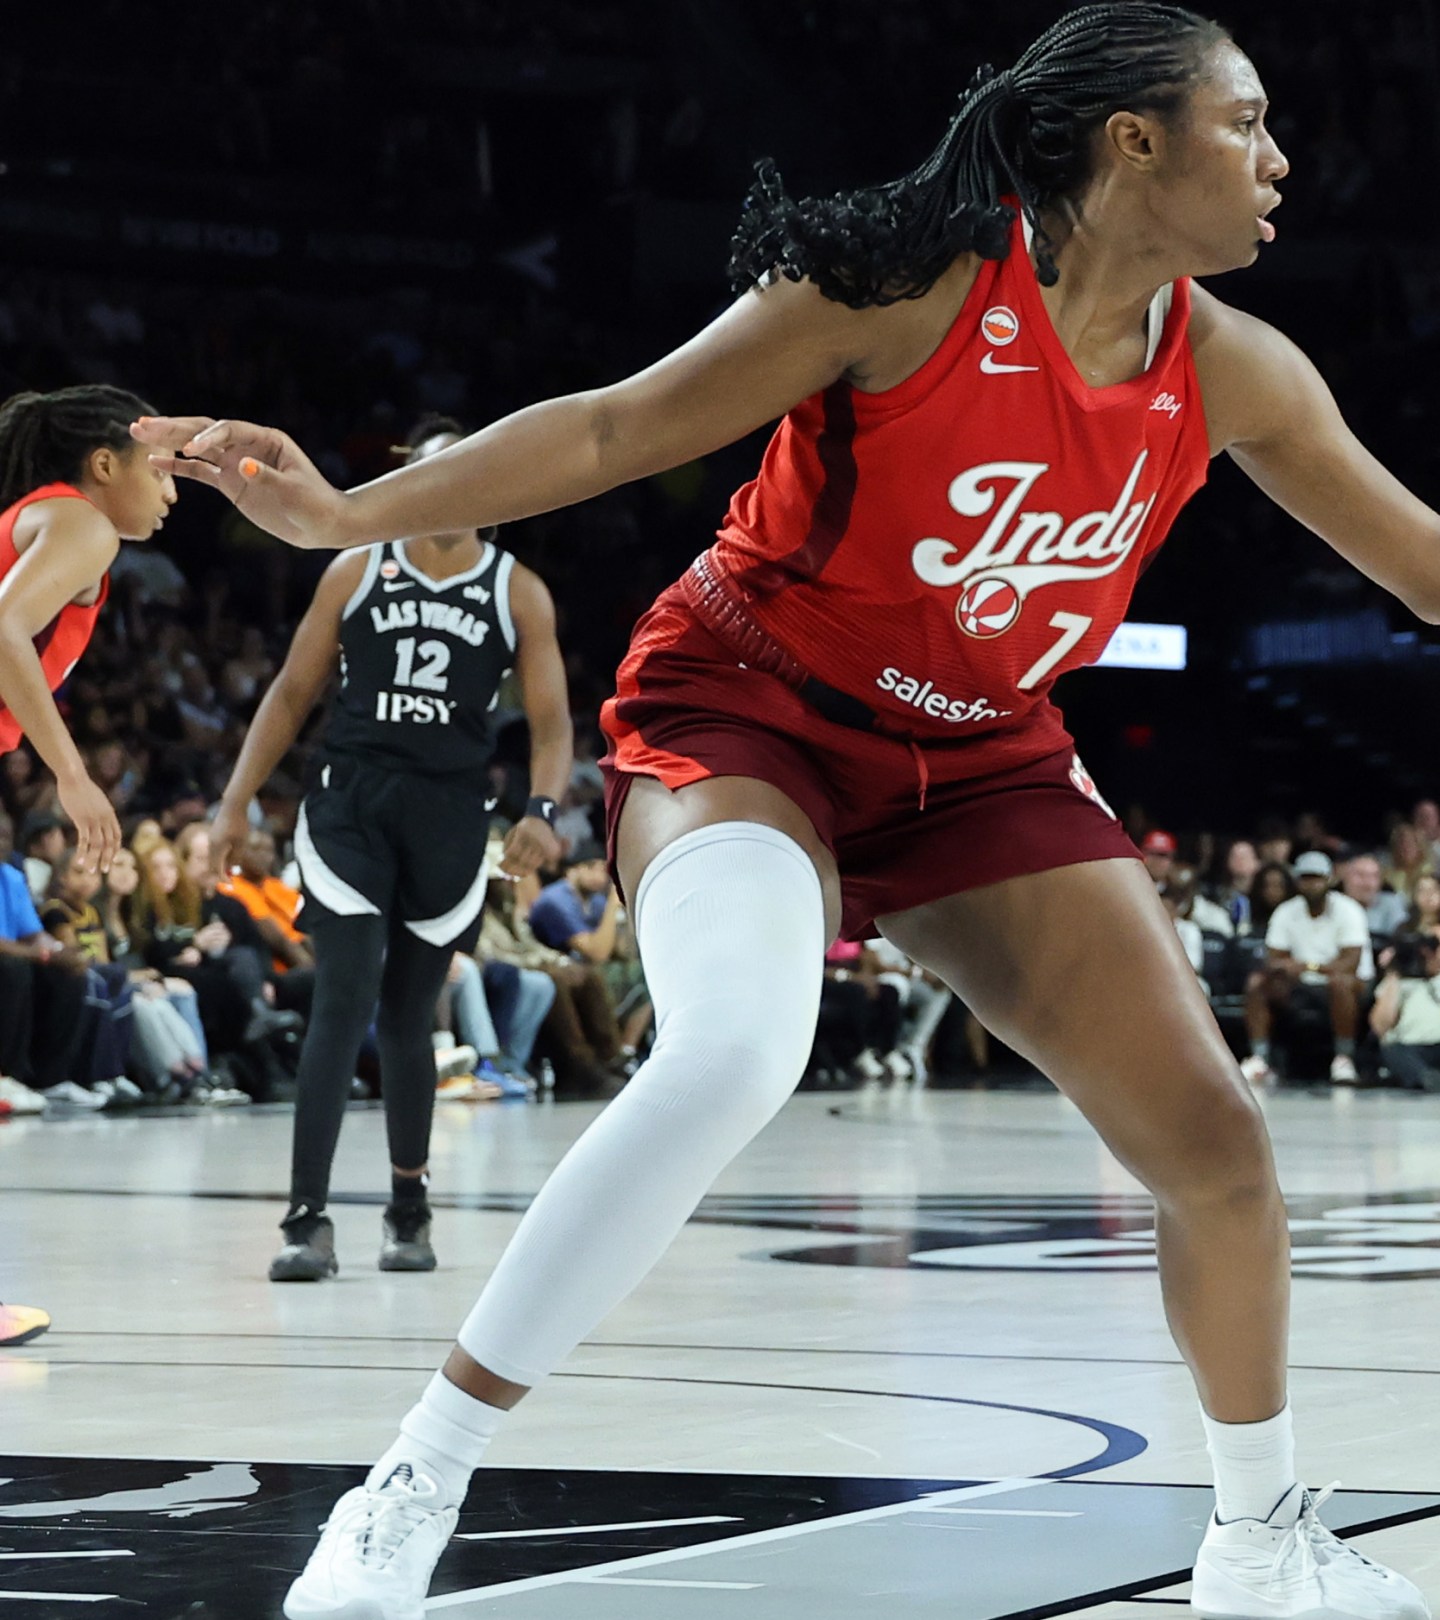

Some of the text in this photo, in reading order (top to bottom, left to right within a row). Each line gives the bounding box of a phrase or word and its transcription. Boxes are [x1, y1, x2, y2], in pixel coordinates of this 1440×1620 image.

[911, 448, 1158, 600] Indy
[370, 599, 490, 648] LAS VEGAS
[1016, 611, 1094, 690] 7
[393, 636, 452, 692] 12
[376, 691, 458, 725] IPSY
